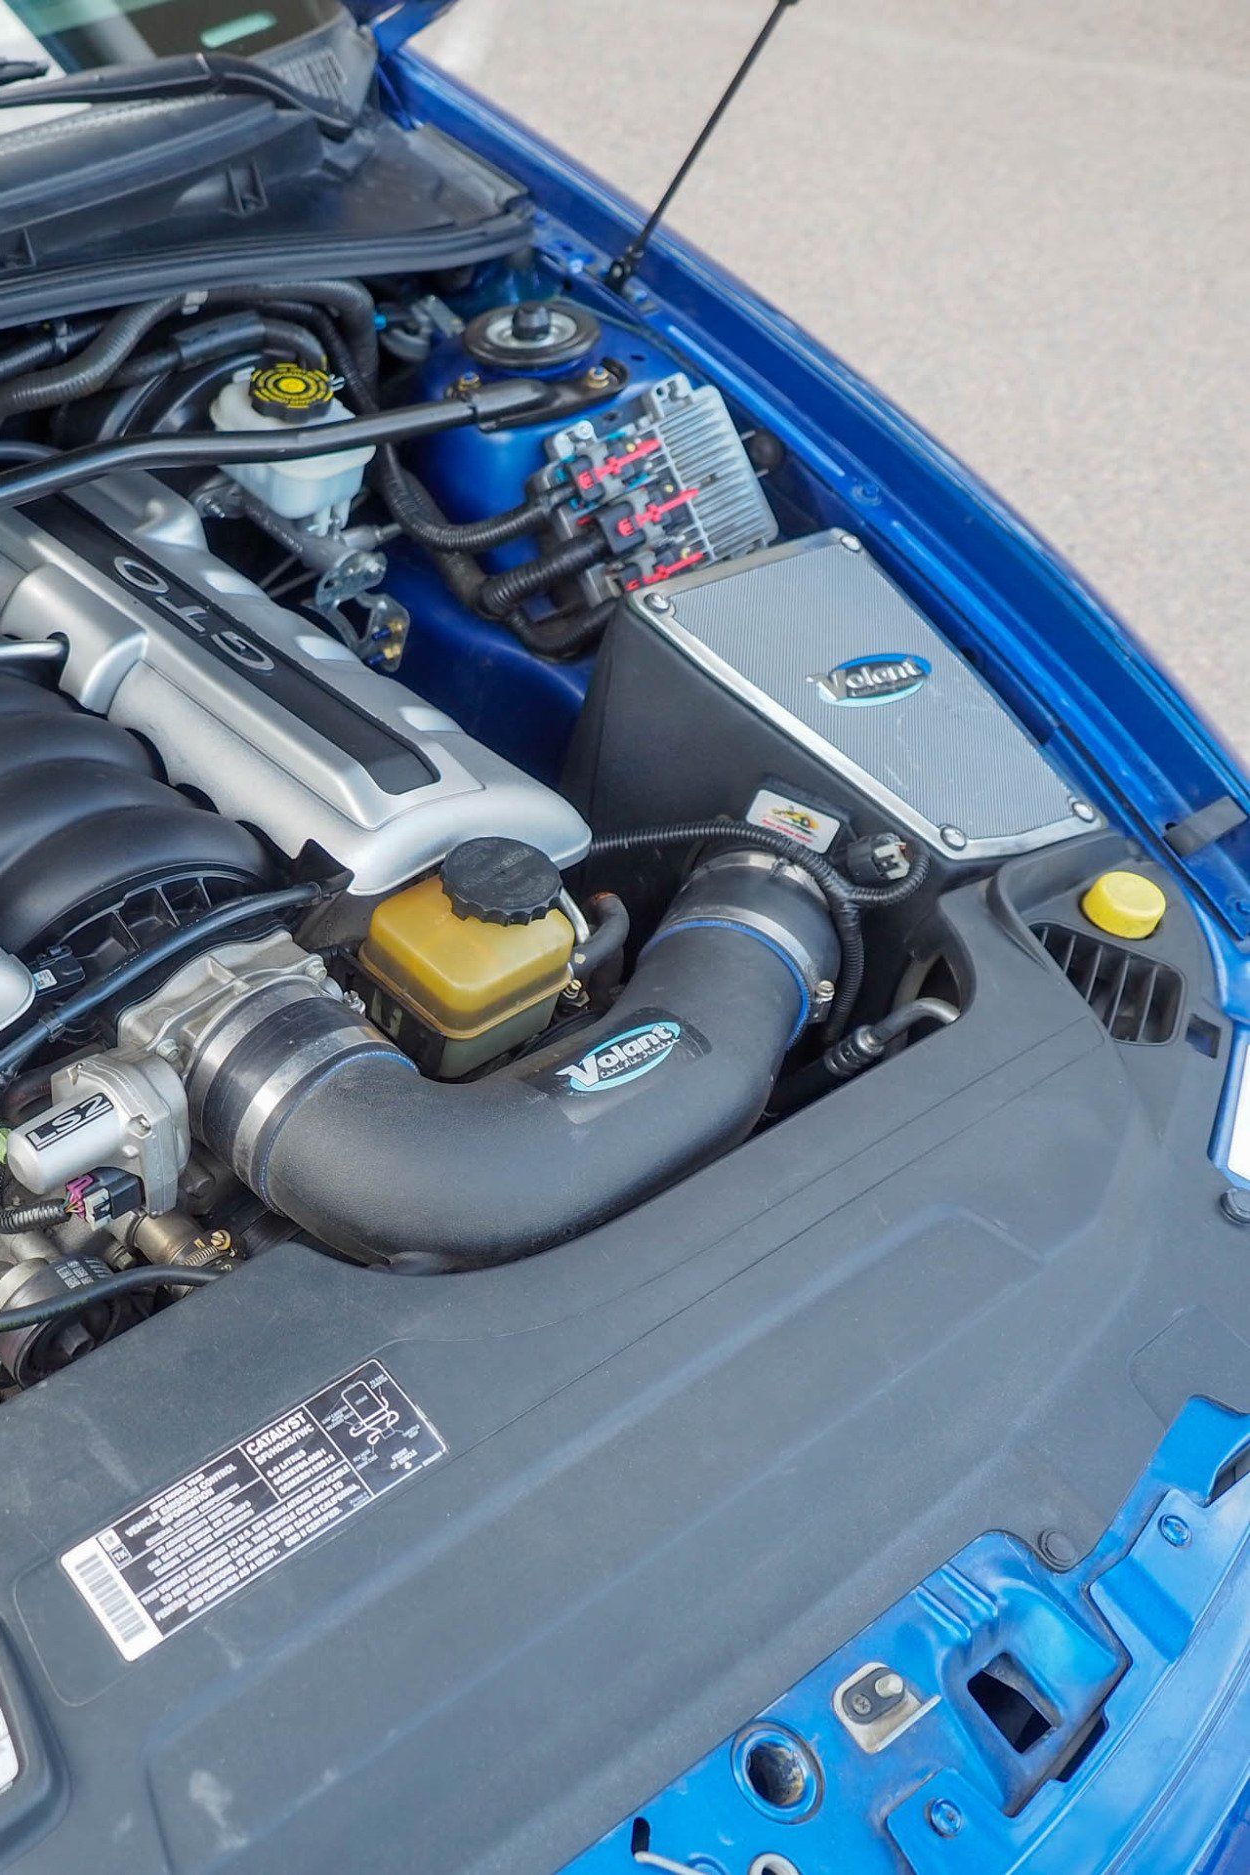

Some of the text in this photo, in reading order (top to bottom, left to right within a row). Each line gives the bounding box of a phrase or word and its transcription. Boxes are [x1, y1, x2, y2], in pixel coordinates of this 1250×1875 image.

[114, 556, 275, 671] GTO
[555, 1025, 672, 1086] Volant
[28, 1094, 109, 1145] LS2
[244, 1409, 308, 1457] CATALYST
